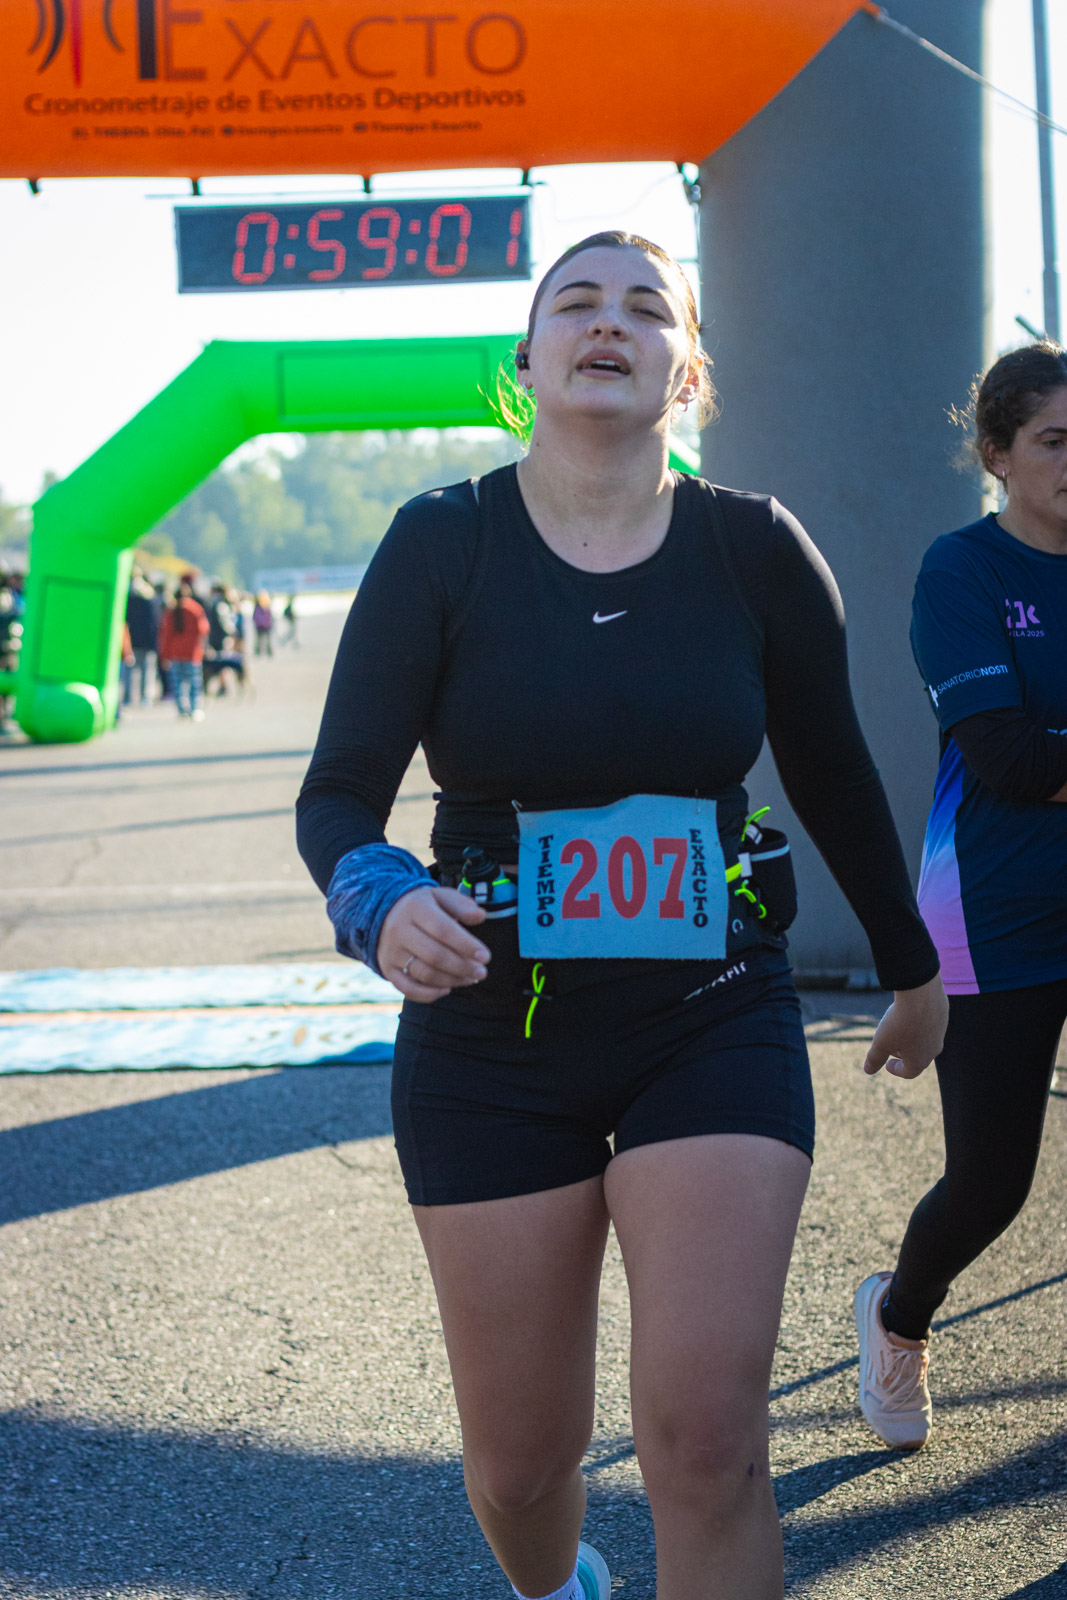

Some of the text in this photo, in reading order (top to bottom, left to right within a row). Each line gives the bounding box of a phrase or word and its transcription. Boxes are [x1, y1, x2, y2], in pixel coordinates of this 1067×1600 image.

[24, 87, 527, 118] Cronometraje de Eventos Deportivos
[536, 834, 555, 928] TIEMPO
[560, 835, 689, 919] 207
[689, 828, 709, 928] EXACTO
